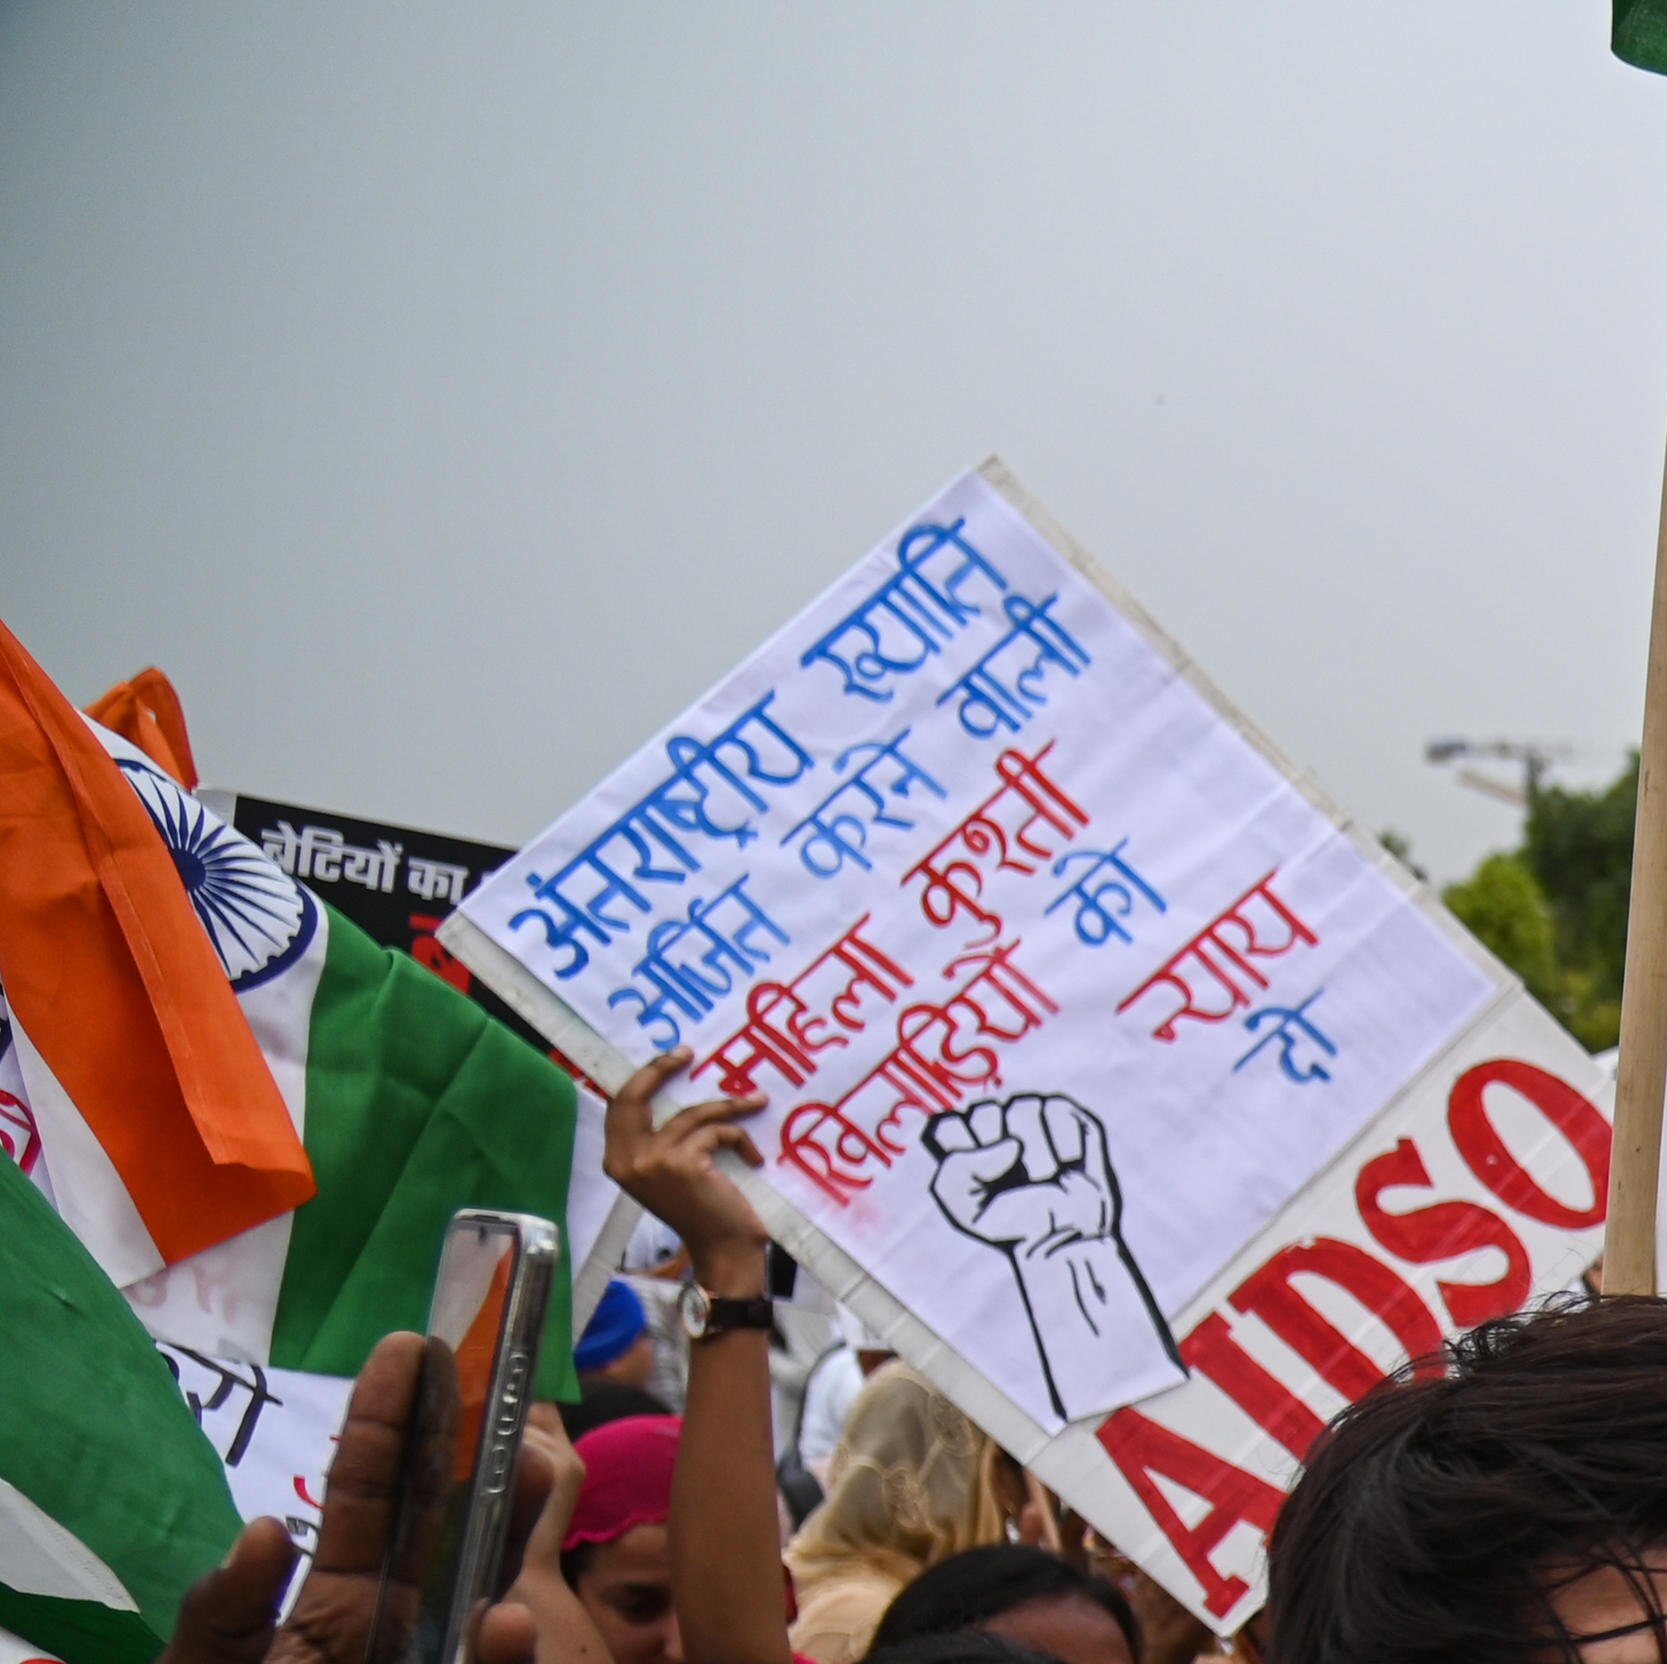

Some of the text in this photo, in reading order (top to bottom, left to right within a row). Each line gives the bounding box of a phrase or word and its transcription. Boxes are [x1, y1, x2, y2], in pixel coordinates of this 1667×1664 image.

[800, 517, 1008, 703] ख्याति
[408, 856, 470, 907] का
[607, 873, 791, 1049] अर्जित
[780, 726, 948, 878] करने
[935, 593, 1091, 739] वाली
[1043, 836, 1168, 947] को
[689, 912, 915, 1096] महिला
[901, 739, 1090, 950] कुश्ती
[1113, 864, 1320, 1044] न्याय
[1232, 986, 1339, 1084] दो
[1096, 1058, 1612, 1619] AIDSO
